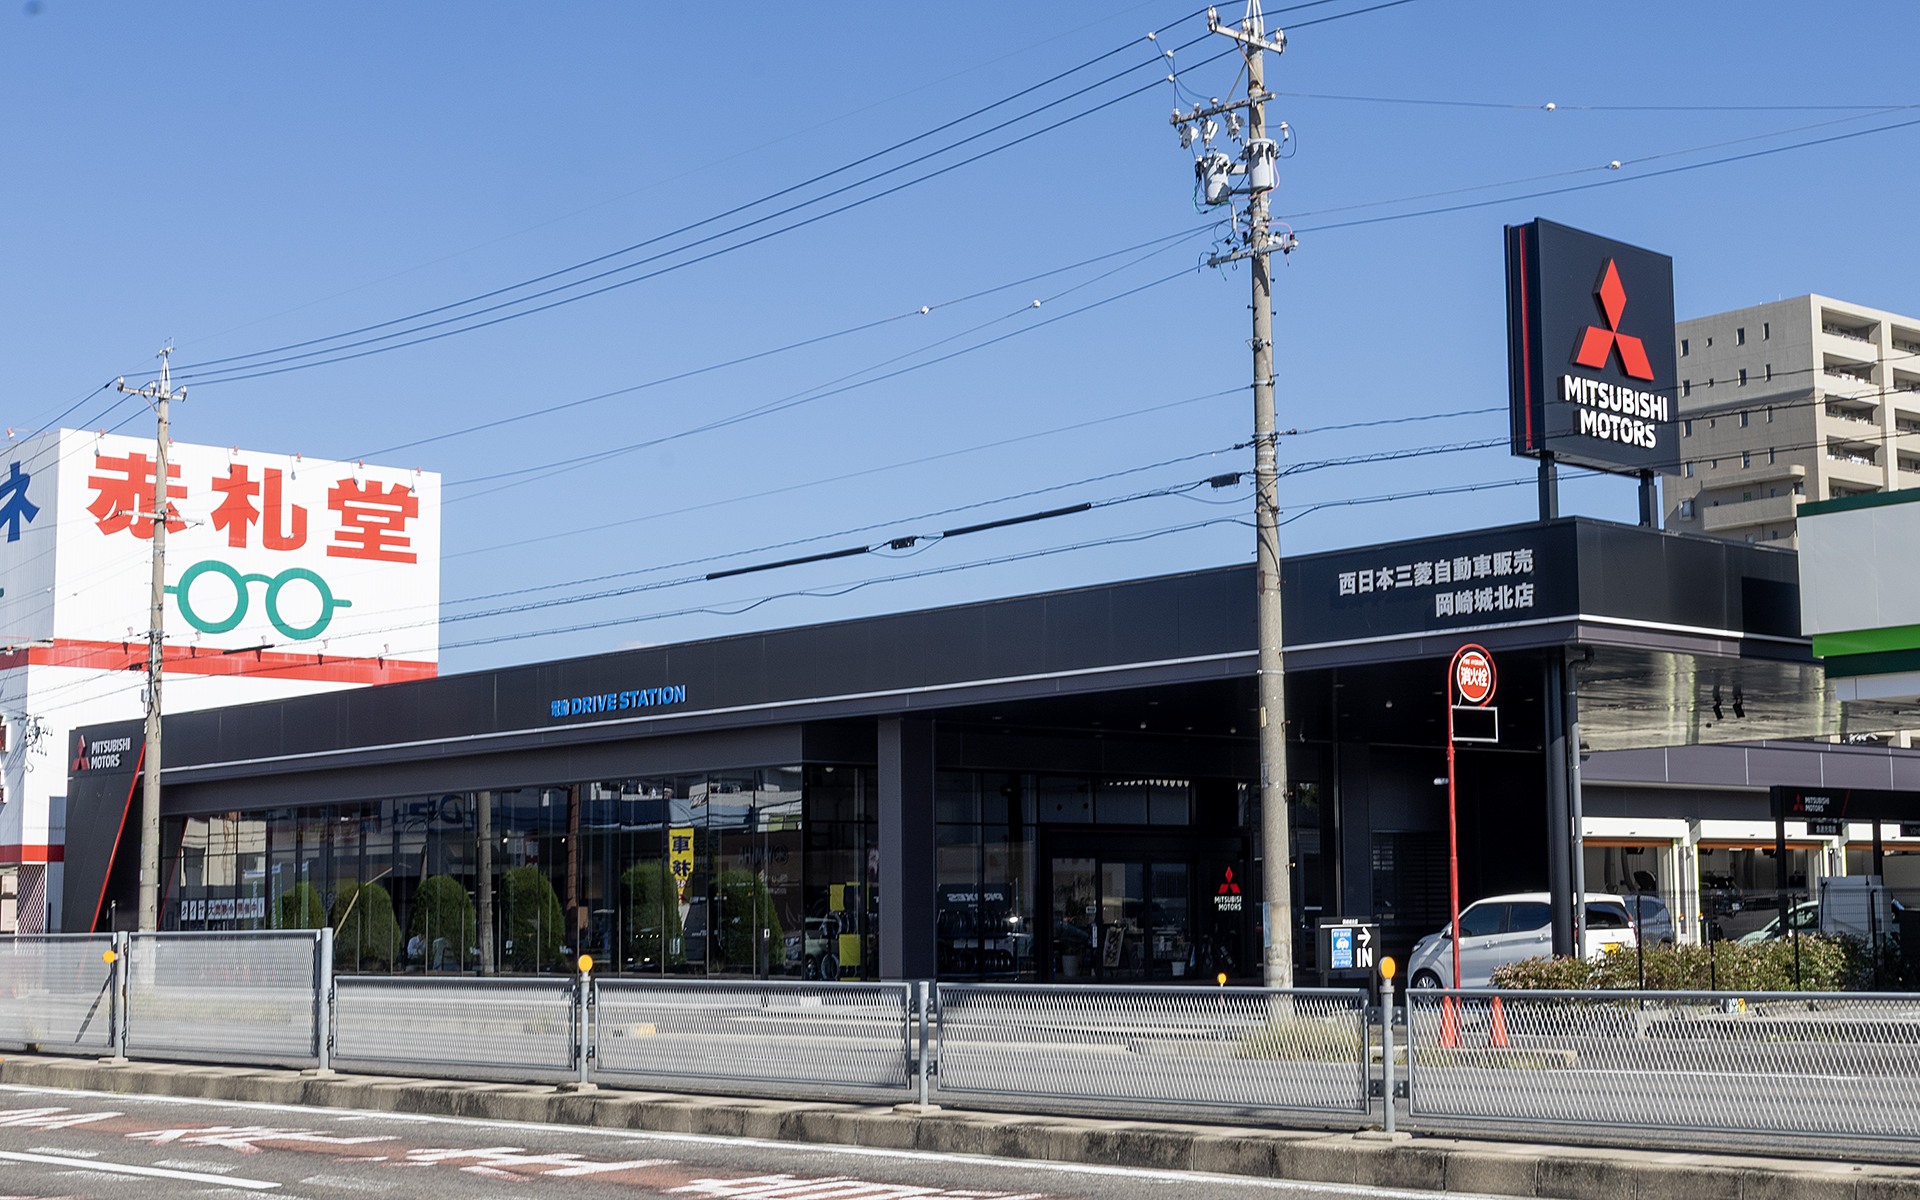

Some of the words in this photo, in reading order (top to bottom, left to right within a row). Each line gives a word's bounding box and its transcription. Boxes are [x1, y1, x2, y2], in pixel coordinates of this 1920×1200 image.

[1564, 374, 1669, 422] MITSUBISHI
[1579, 408, 1657, 449] MOTORS
[86, 452, 419, 564] 赤札堂
[1338, 548, 1534, 597] 西日本三菱自動車販売
[1435, 582, 1534, 618] 岡崎城北店
[1460, 666, 1488, 687] 消火栓
[571, 693, 617, 715] DRIVE
[619, 684, 687, 709] STATION
[91, 737, 131, 755] MITSUBISHI
[91, 753, 121, 770] MOTORS
[1218, 903, 1242, 912] MOTORS
[1356, 947, 1373, 968] IN
